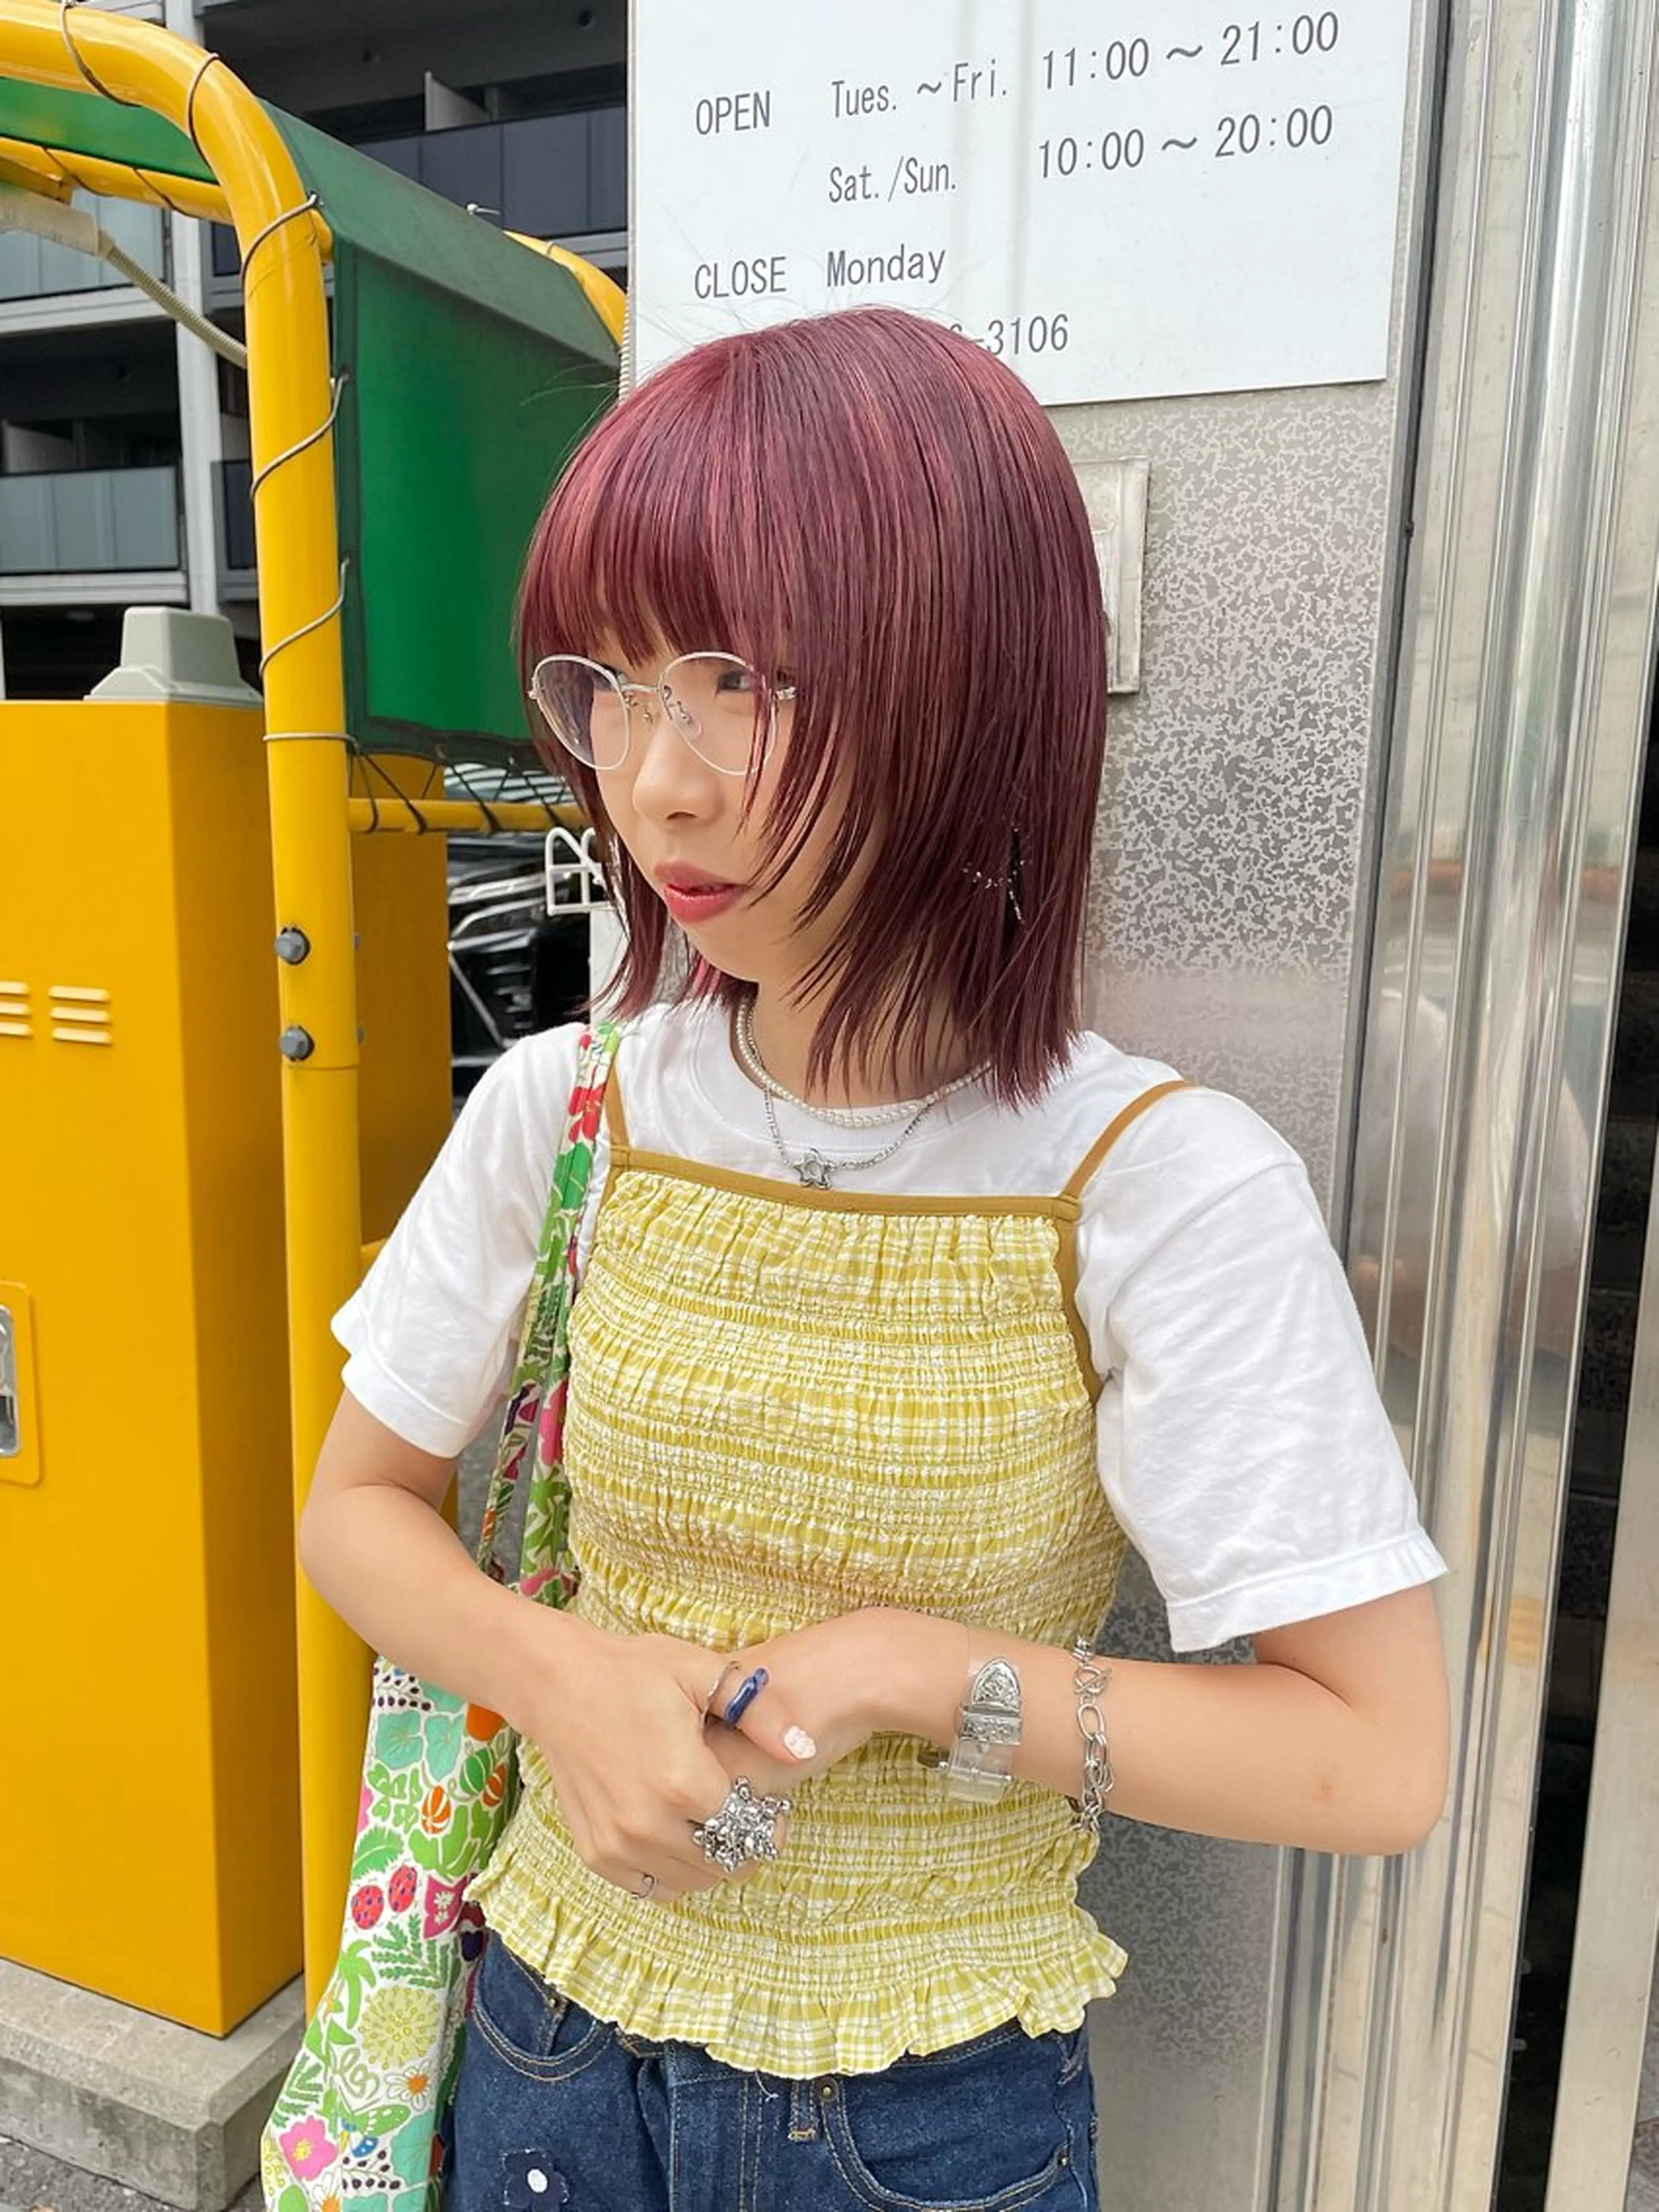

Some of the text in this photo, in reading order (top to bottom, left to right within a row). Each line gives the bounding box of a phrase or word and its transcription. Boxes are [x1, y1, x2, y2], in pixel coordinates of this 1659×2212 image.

[696, 90, 770, 135] OPEN
[831, 80, 897, 118] Tues.
[1043, 38, 1149, 89] 11:00
[1220, 11, 1338, 66] 21:00
[1039, 128, 1144, 178] 10:00
[1214, 105, 1332, 158] 20:00
[694, 243, 946, 299] CLOSE Monday
